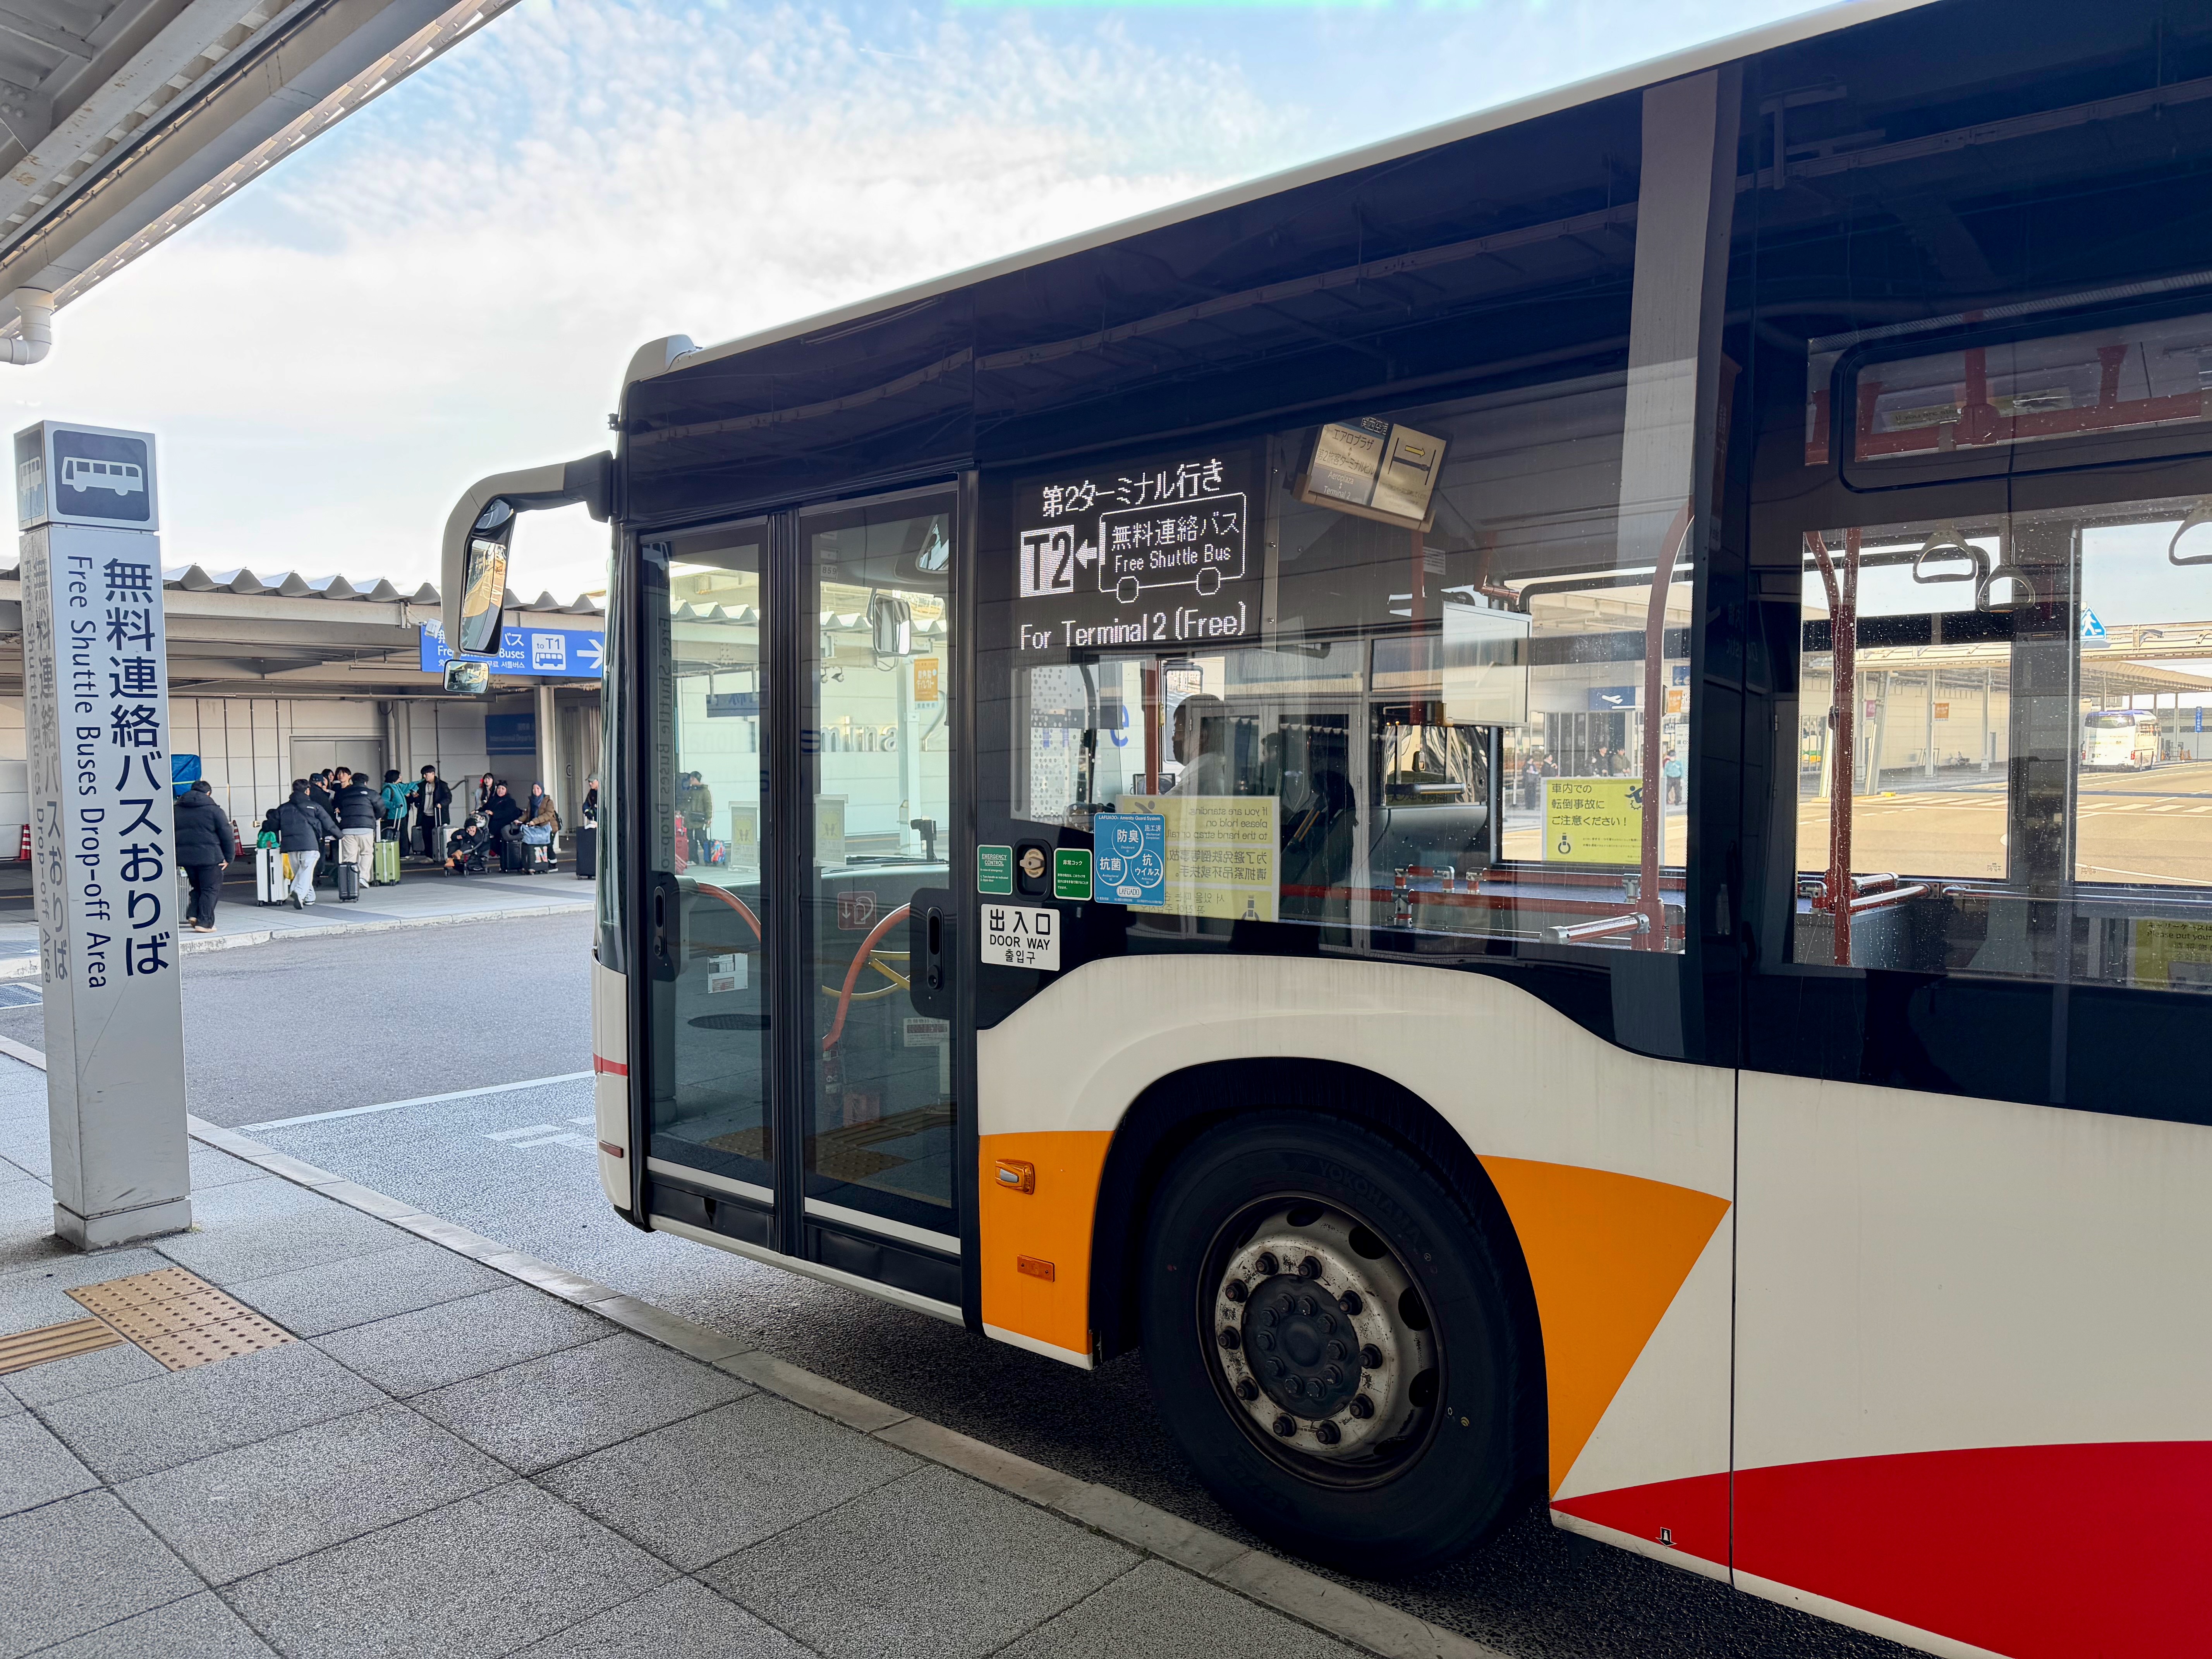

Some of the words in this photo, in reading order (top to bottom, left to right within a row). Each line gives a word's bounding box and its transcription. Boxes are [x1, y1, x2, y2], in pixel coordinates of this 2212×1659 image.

[1332, 429, 1374, 450] エアロプラザ
[1328, 471, 1354, 485] Aeroplaza
[1042, 458, 1223, 518] 第2ターミナル行き
[1324, 486, 1345, 498] Terminal
[1111, 512, 1240, 551] 無料連絡バス
[1023, 532, 1072, 591] T2
[1115, 554, 1144, 573] Free
[1150, 551, 1198, 569] Shuttle
[1204, 544, 1231, 562] Bus
[822, 567, 836, 575] 859
[68, 556, 93, 608] Free
[1020, 624, 1051, 650] For
[1062, 613, 1147, 647] Terminal
[1153, 612, 1166, 640] 2
[1175, 601, 1246, 641] (Free)
[438, 646, 453, 656] Fre
[499, 649, 525, 659] Buses
[546, 638, 561, 650] T1
[71, 620, 100, 713] Shuttle
[75, 726, 101, 796] Buses
[103, 558, 170, 977] 無料連絡バスおりば
[1552, 783, 1592, 794] 車内での
[1551, 799, 1605, 810] 転倒事故に
[1117, 829, 1139, 843] 防臭
[534, 846, 548, 864] N
[1100, 857, 1121, 871] 抗菌
[1142, 854, 1152, 866] 抗
[75, 808, 111, 921] Drop-off
[1135, 867, 1160, 876] ウイルス
[989, 934, 1021, 948] DOOR
[1027, 937, 1050, 951] WAY
[86, 932, 111, 989] Area
[1005, 949, 1036, 965] 출입구
[1318, 1159, 1422, 1247] YOKOHAMA
